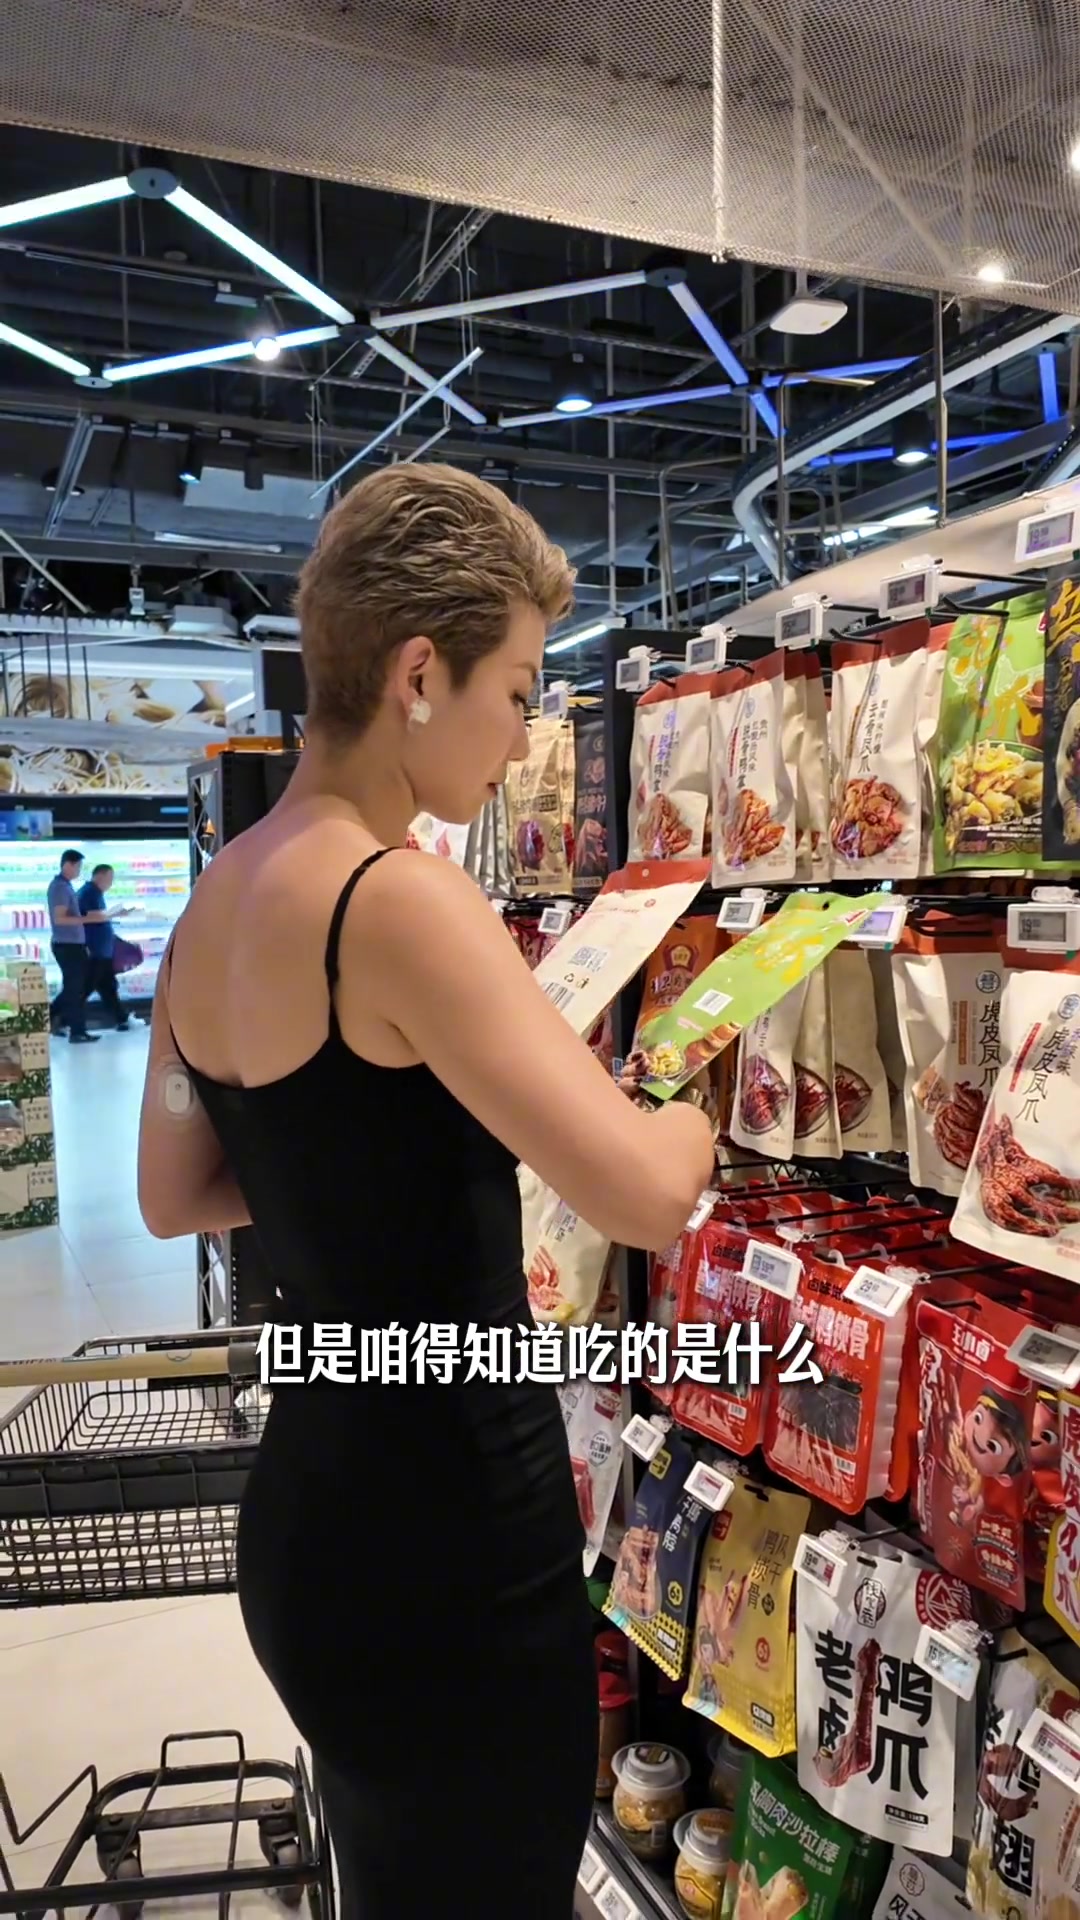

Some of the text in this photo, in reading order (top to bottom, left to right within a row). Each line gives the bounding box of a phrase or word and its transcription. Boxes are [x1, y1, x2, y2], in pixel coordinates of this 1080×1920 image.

[1015, 1028, 1069, 1124] 虎皮凤爪
[867, 1653, 933, 1801] 鸭爪
